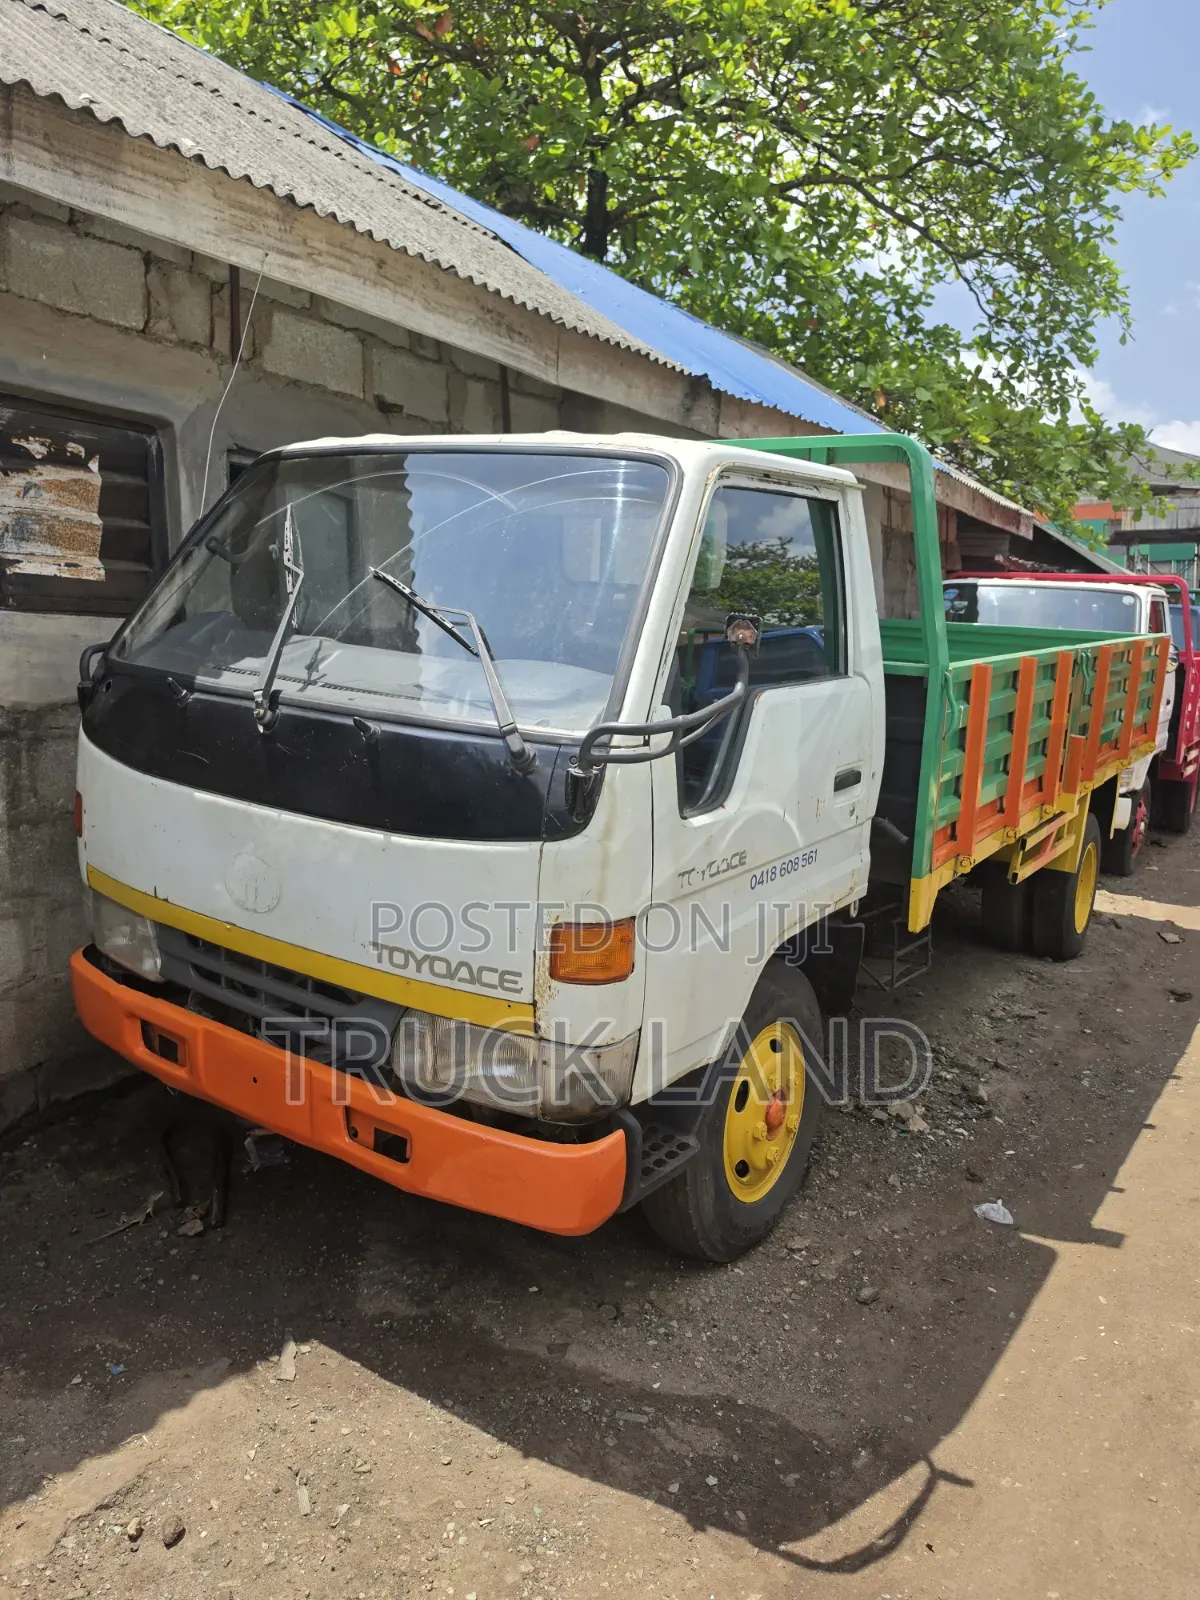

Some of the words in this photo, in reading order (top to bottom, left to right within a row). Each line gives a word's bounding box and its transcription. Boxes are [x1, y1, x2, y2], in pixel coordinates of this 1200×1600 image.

[749, 865, 778, 890] 0418
[779, 856, 800, 878] 608
[801, 849, 818, 868] 561
[368, 940, 523, 995] TOYOACE
